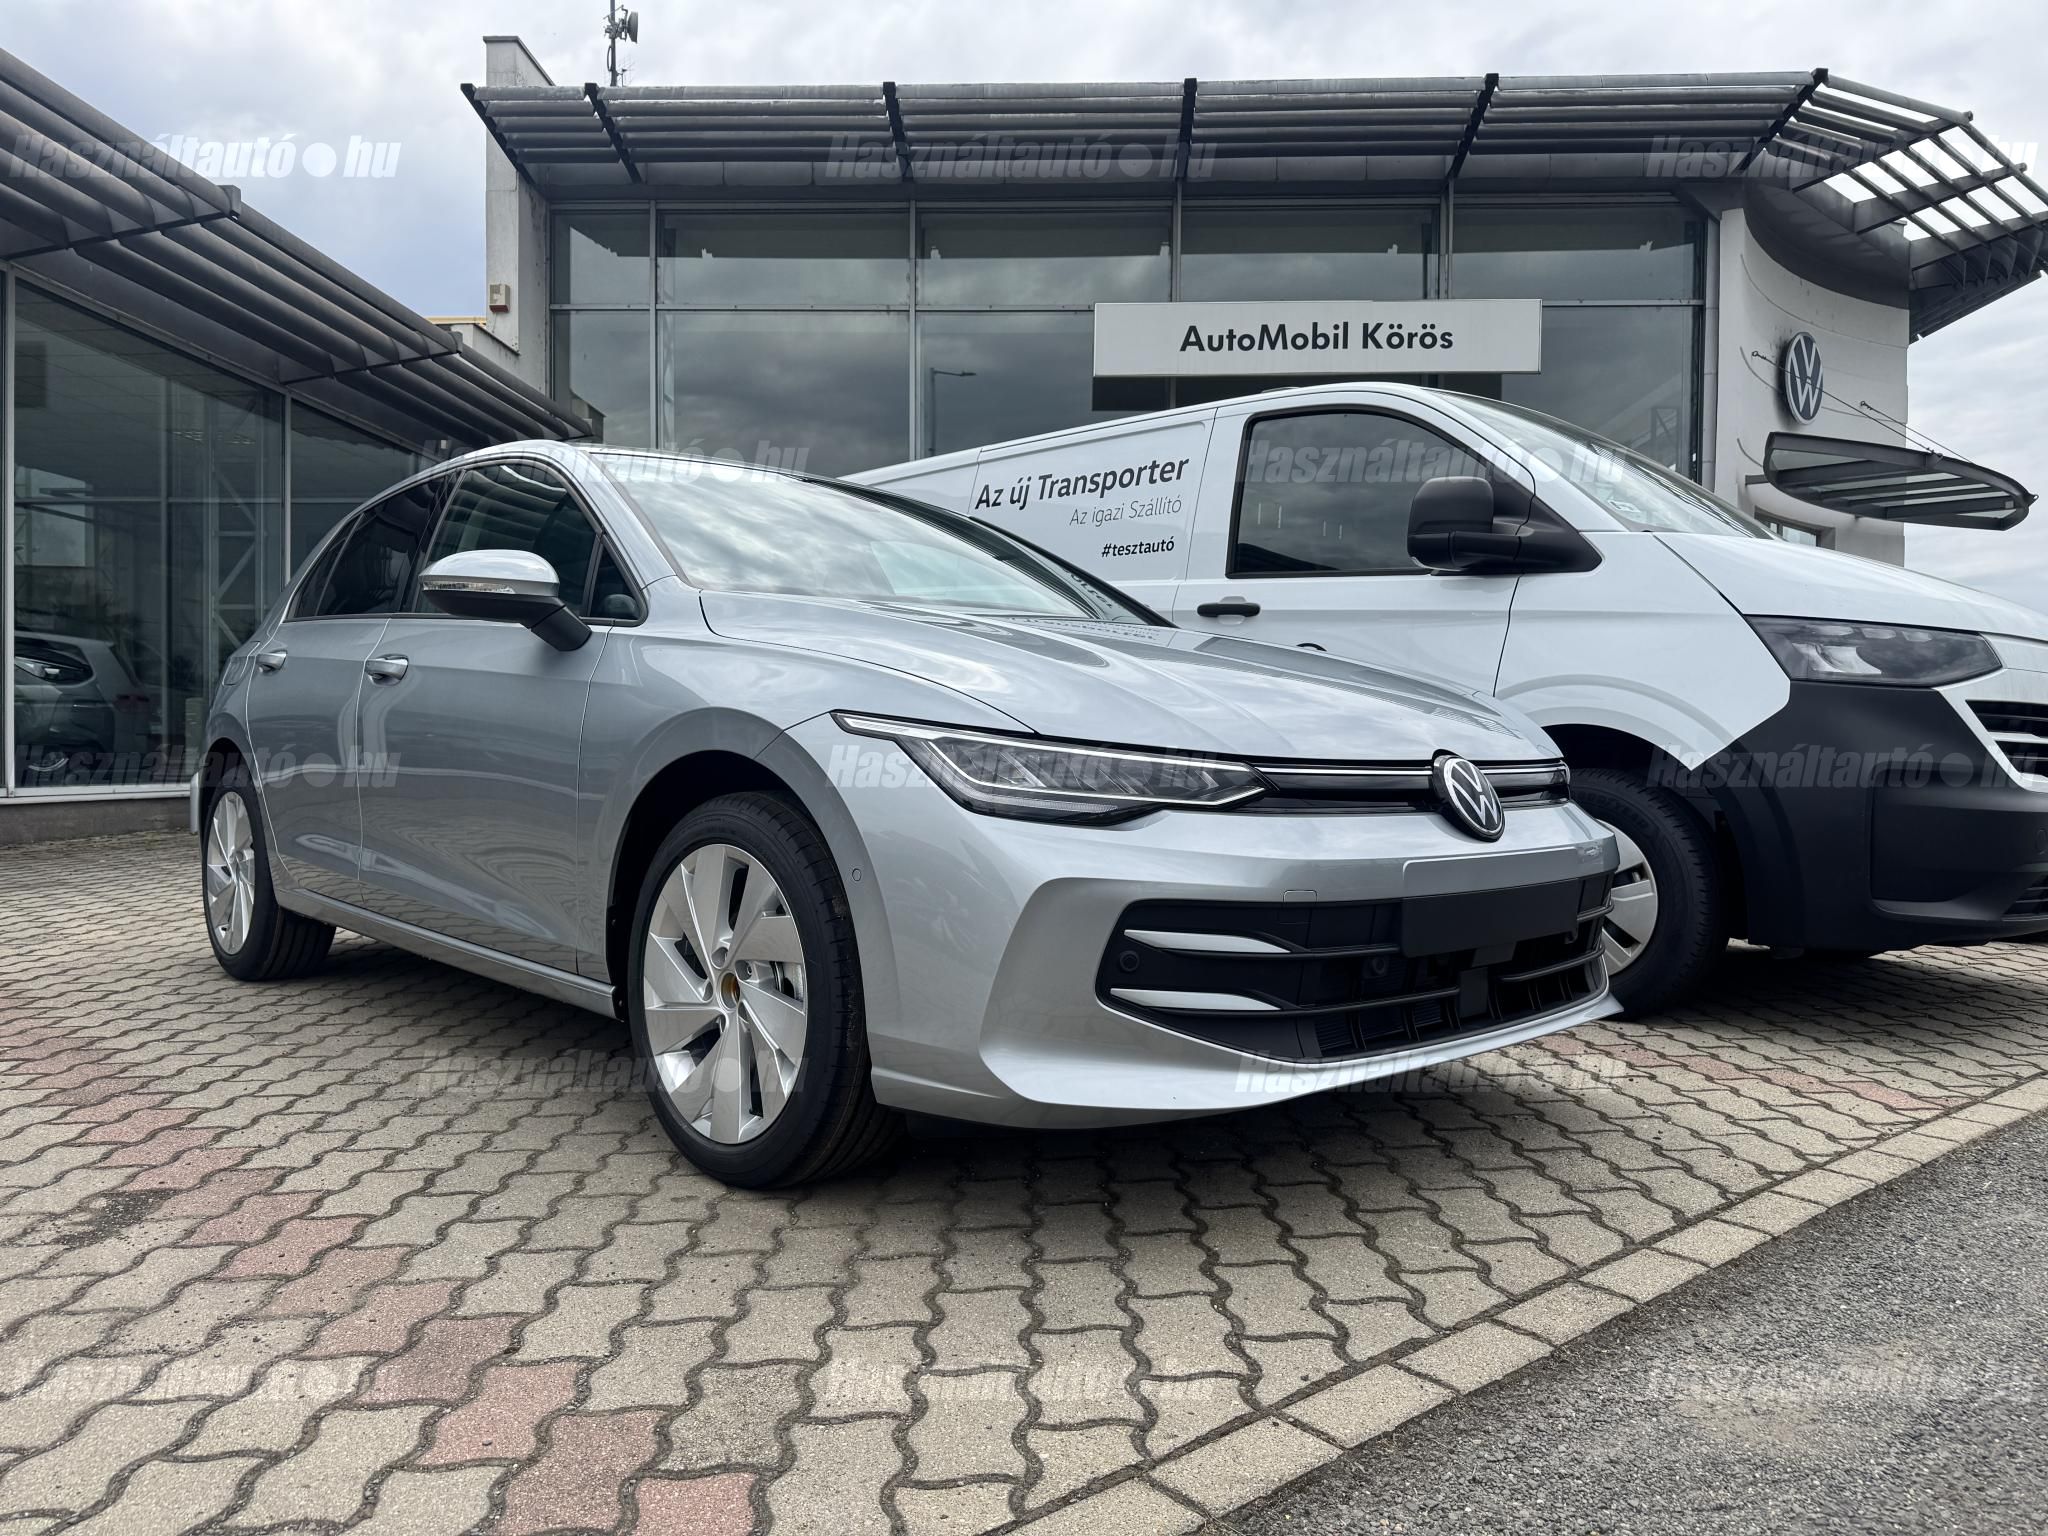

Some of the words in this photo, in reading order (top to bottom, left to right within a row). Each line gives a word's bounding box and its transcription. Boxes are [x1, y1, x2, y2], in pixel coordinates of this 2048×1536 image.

[1180, 321, 1349, 352] AutoMobil
[1361, 321, 1454, 350] Körös
[975, 484, 1004, 510] Az
[1009, 476, 1032, 510] új
[1038, 458, 1190, 500] Transporter
[1069, 508, 1087, 526] Az
[1091, 505, 1125, 528] igazi
[1129, 494, 1183, 519] Szállító
[1101, 536, 1175, 558] #tesztautó
[1443, 757, 1504, 834] VW
